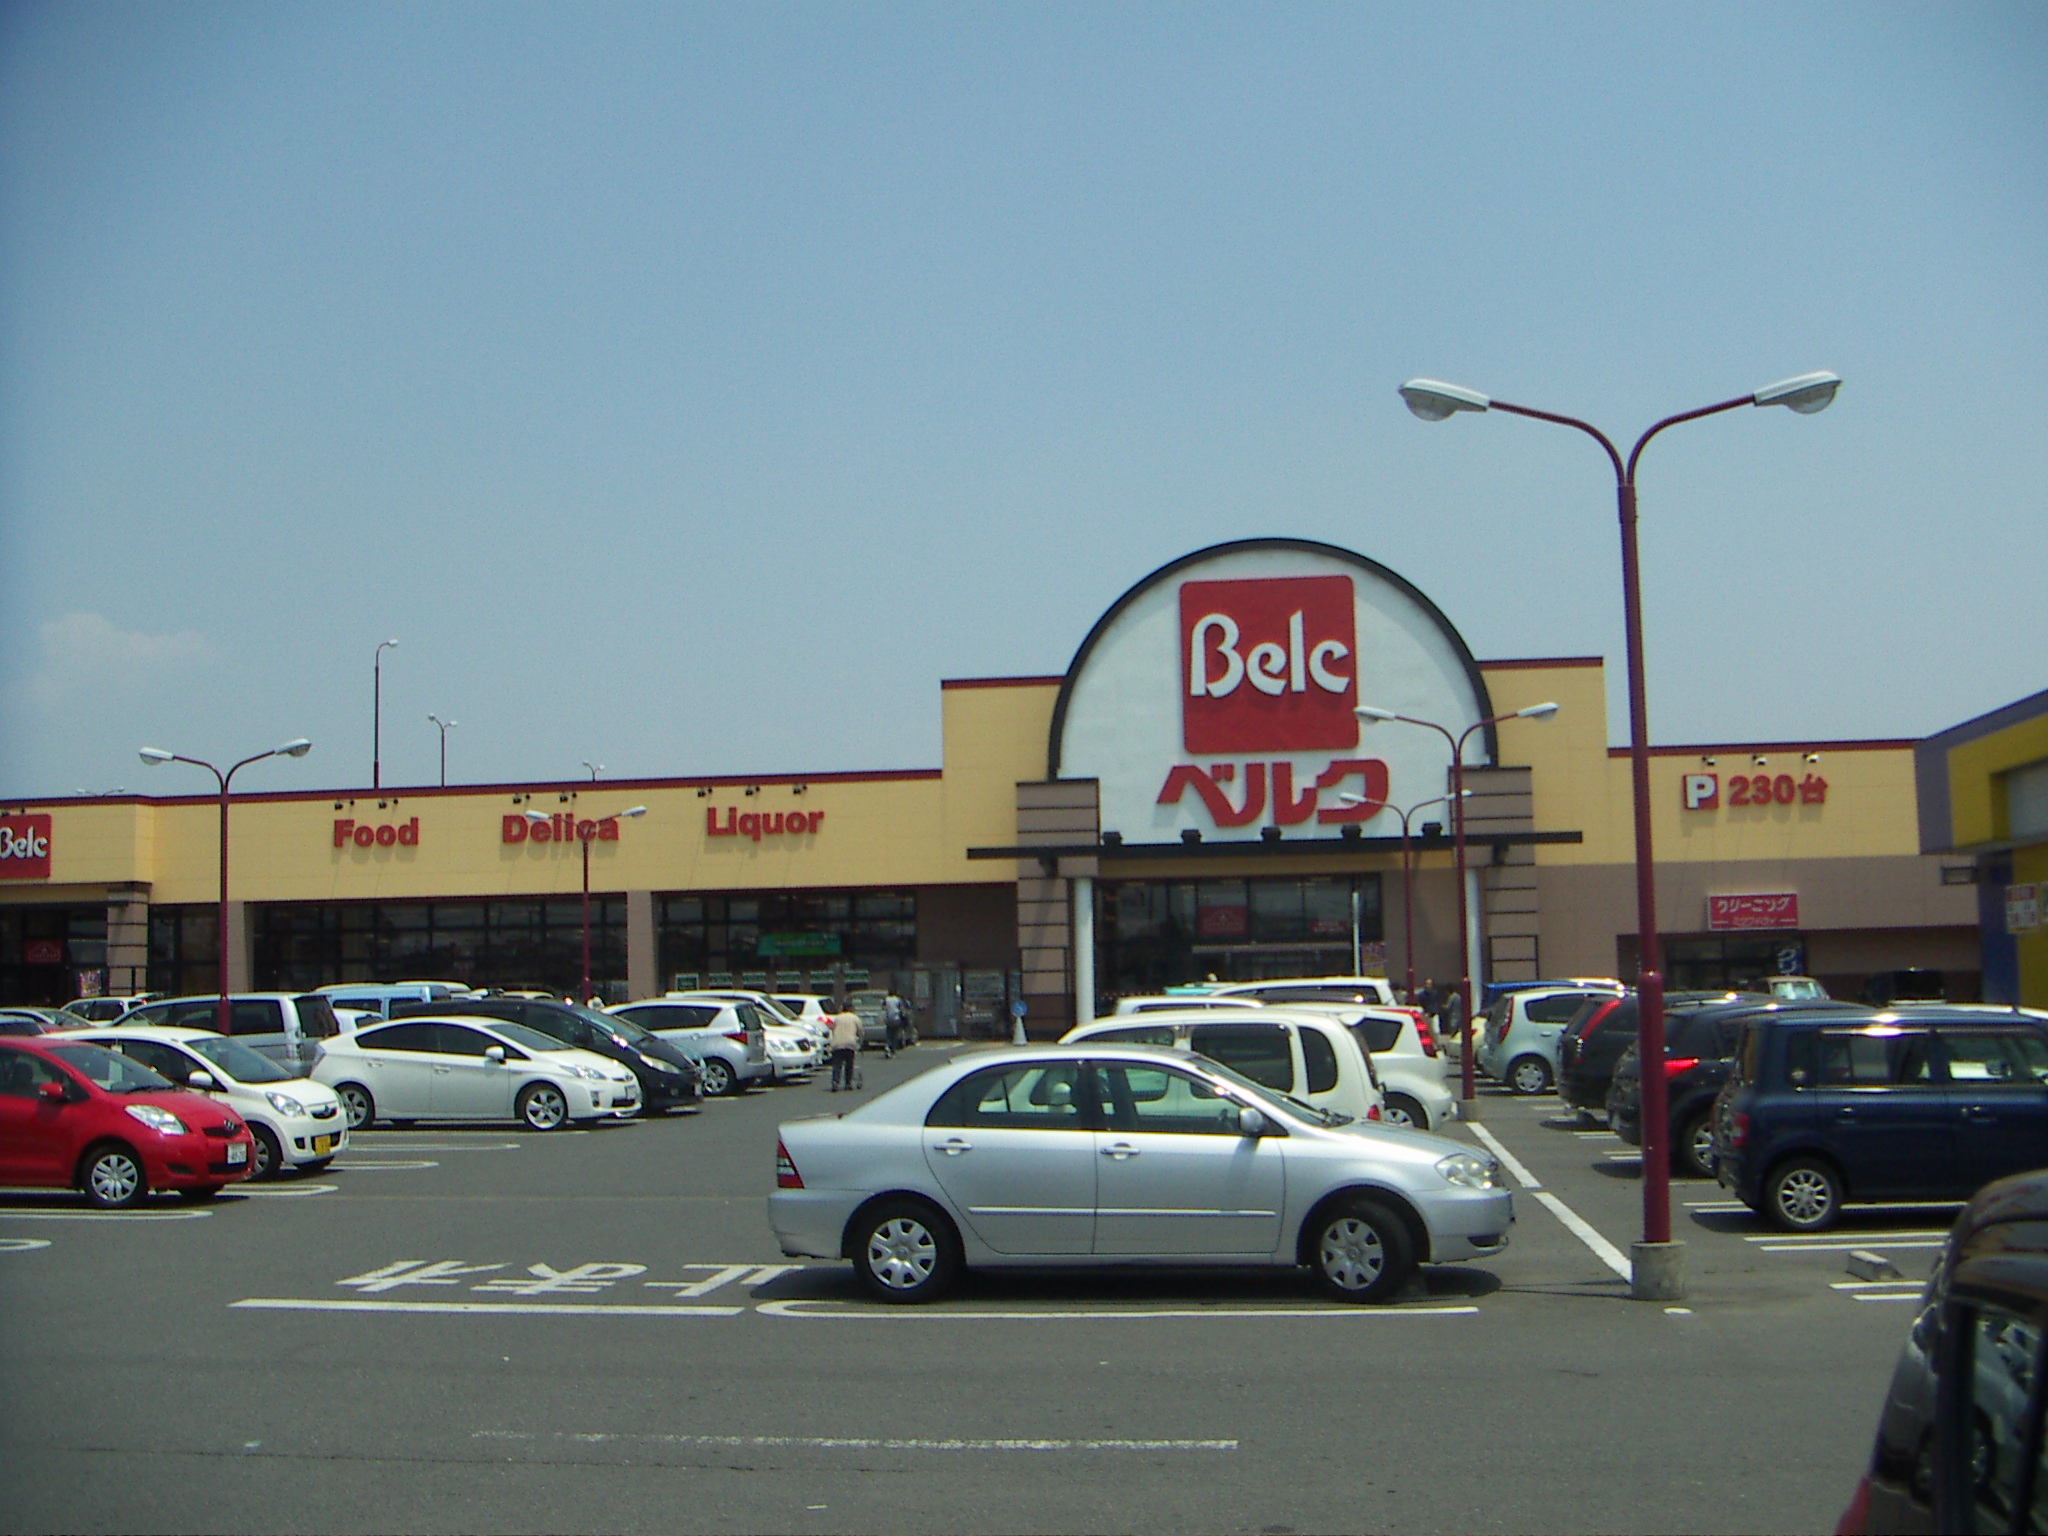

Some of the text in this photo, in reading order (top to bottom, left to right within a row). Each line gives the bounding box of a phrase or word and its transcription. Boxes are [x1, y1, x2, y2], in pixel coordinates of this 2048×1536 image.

[1190, 609, 1351, 698] Belc
[1156, 758, 1389, 827] ベルク
[1686, 775, 1716, 809] P
[334, 816, 419, 848] Food
[502, 812, 619, 843] Delica
[707, 806, 825, 842] Liquor
[1717, 896, 1790, 914] クリーニング
